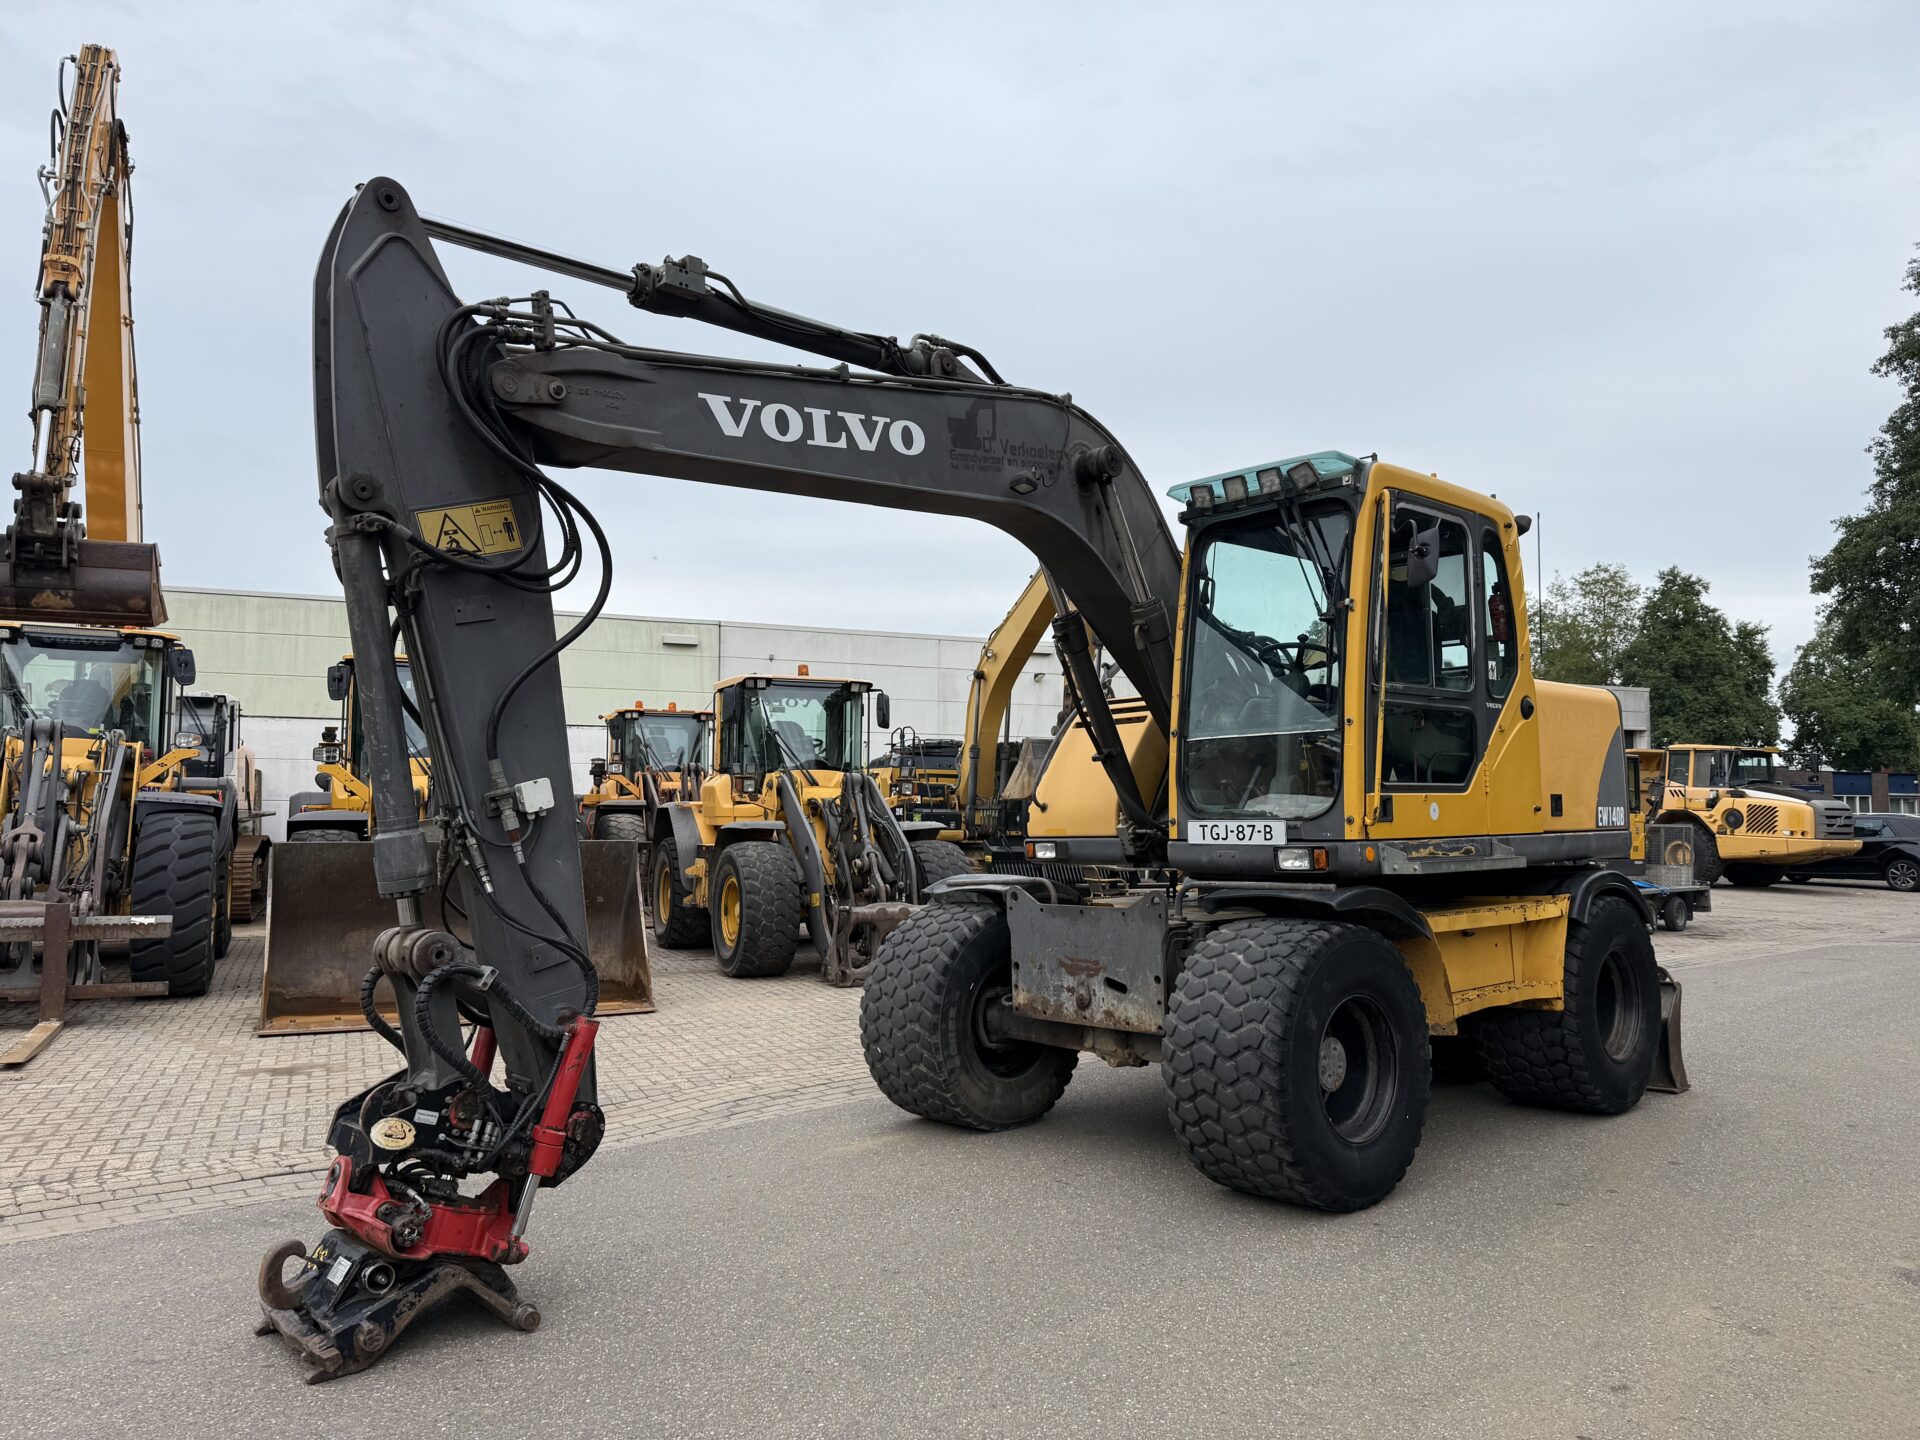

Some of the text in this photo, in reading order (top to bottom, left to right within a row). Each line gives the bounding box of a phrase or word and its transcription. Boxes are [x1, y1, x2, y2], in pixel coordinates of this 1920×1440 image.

[697, 392, 926, 456] VOLVO
[481, 503, 510, 512] WARNING
[1597, 806, 1624, 827] EW140B
[1199, 824, 1273, 841] TGJ-87-B
